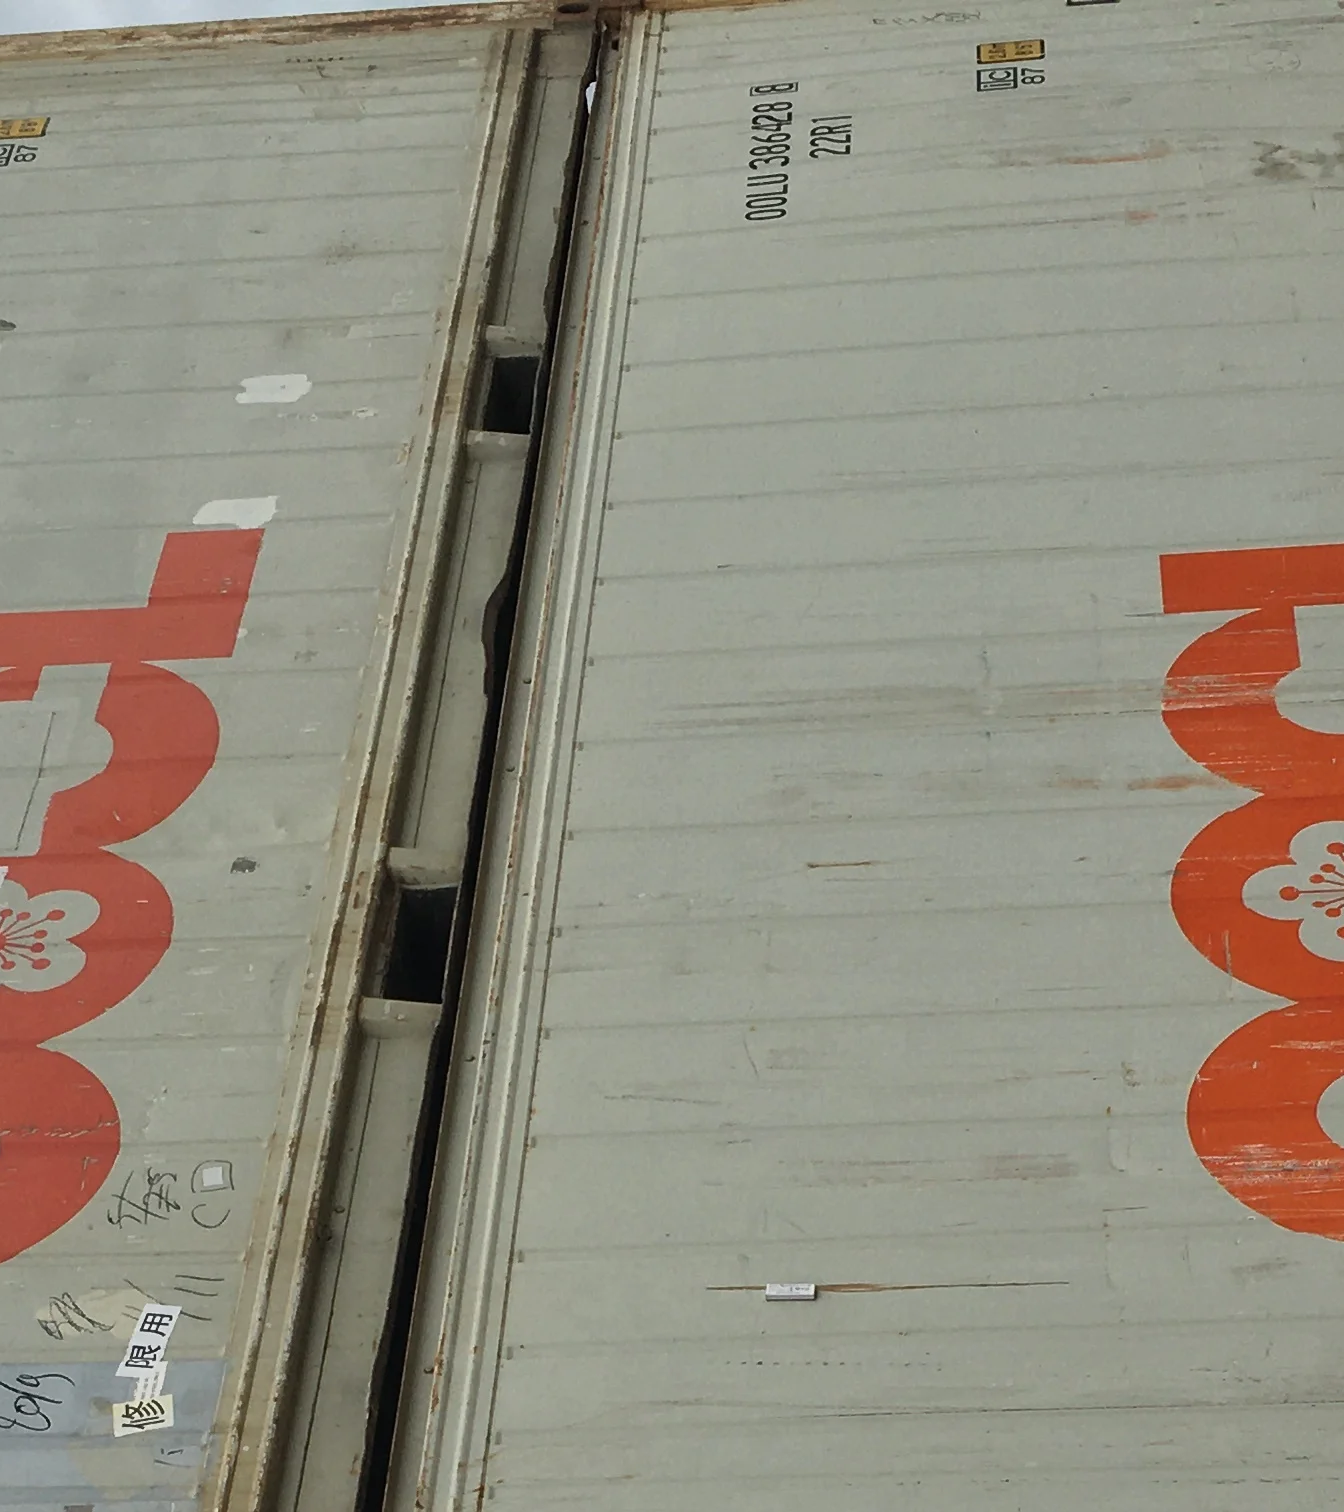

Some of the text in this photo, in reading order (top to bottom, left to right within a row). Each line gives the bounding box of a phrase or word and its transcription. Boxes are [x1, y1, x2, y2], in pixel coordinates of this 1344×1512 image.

[1021, 67, 1045, 85] 87
[13, 144, 38, 162] 87
[748, 101, 793, 170] 386428
[809, 115, 853, 159] 22R1
[744, 174, 788, 221] OOLU
[124, 1312, 173, 1369] 限用
[121, 1399, 165, 1429] 修
